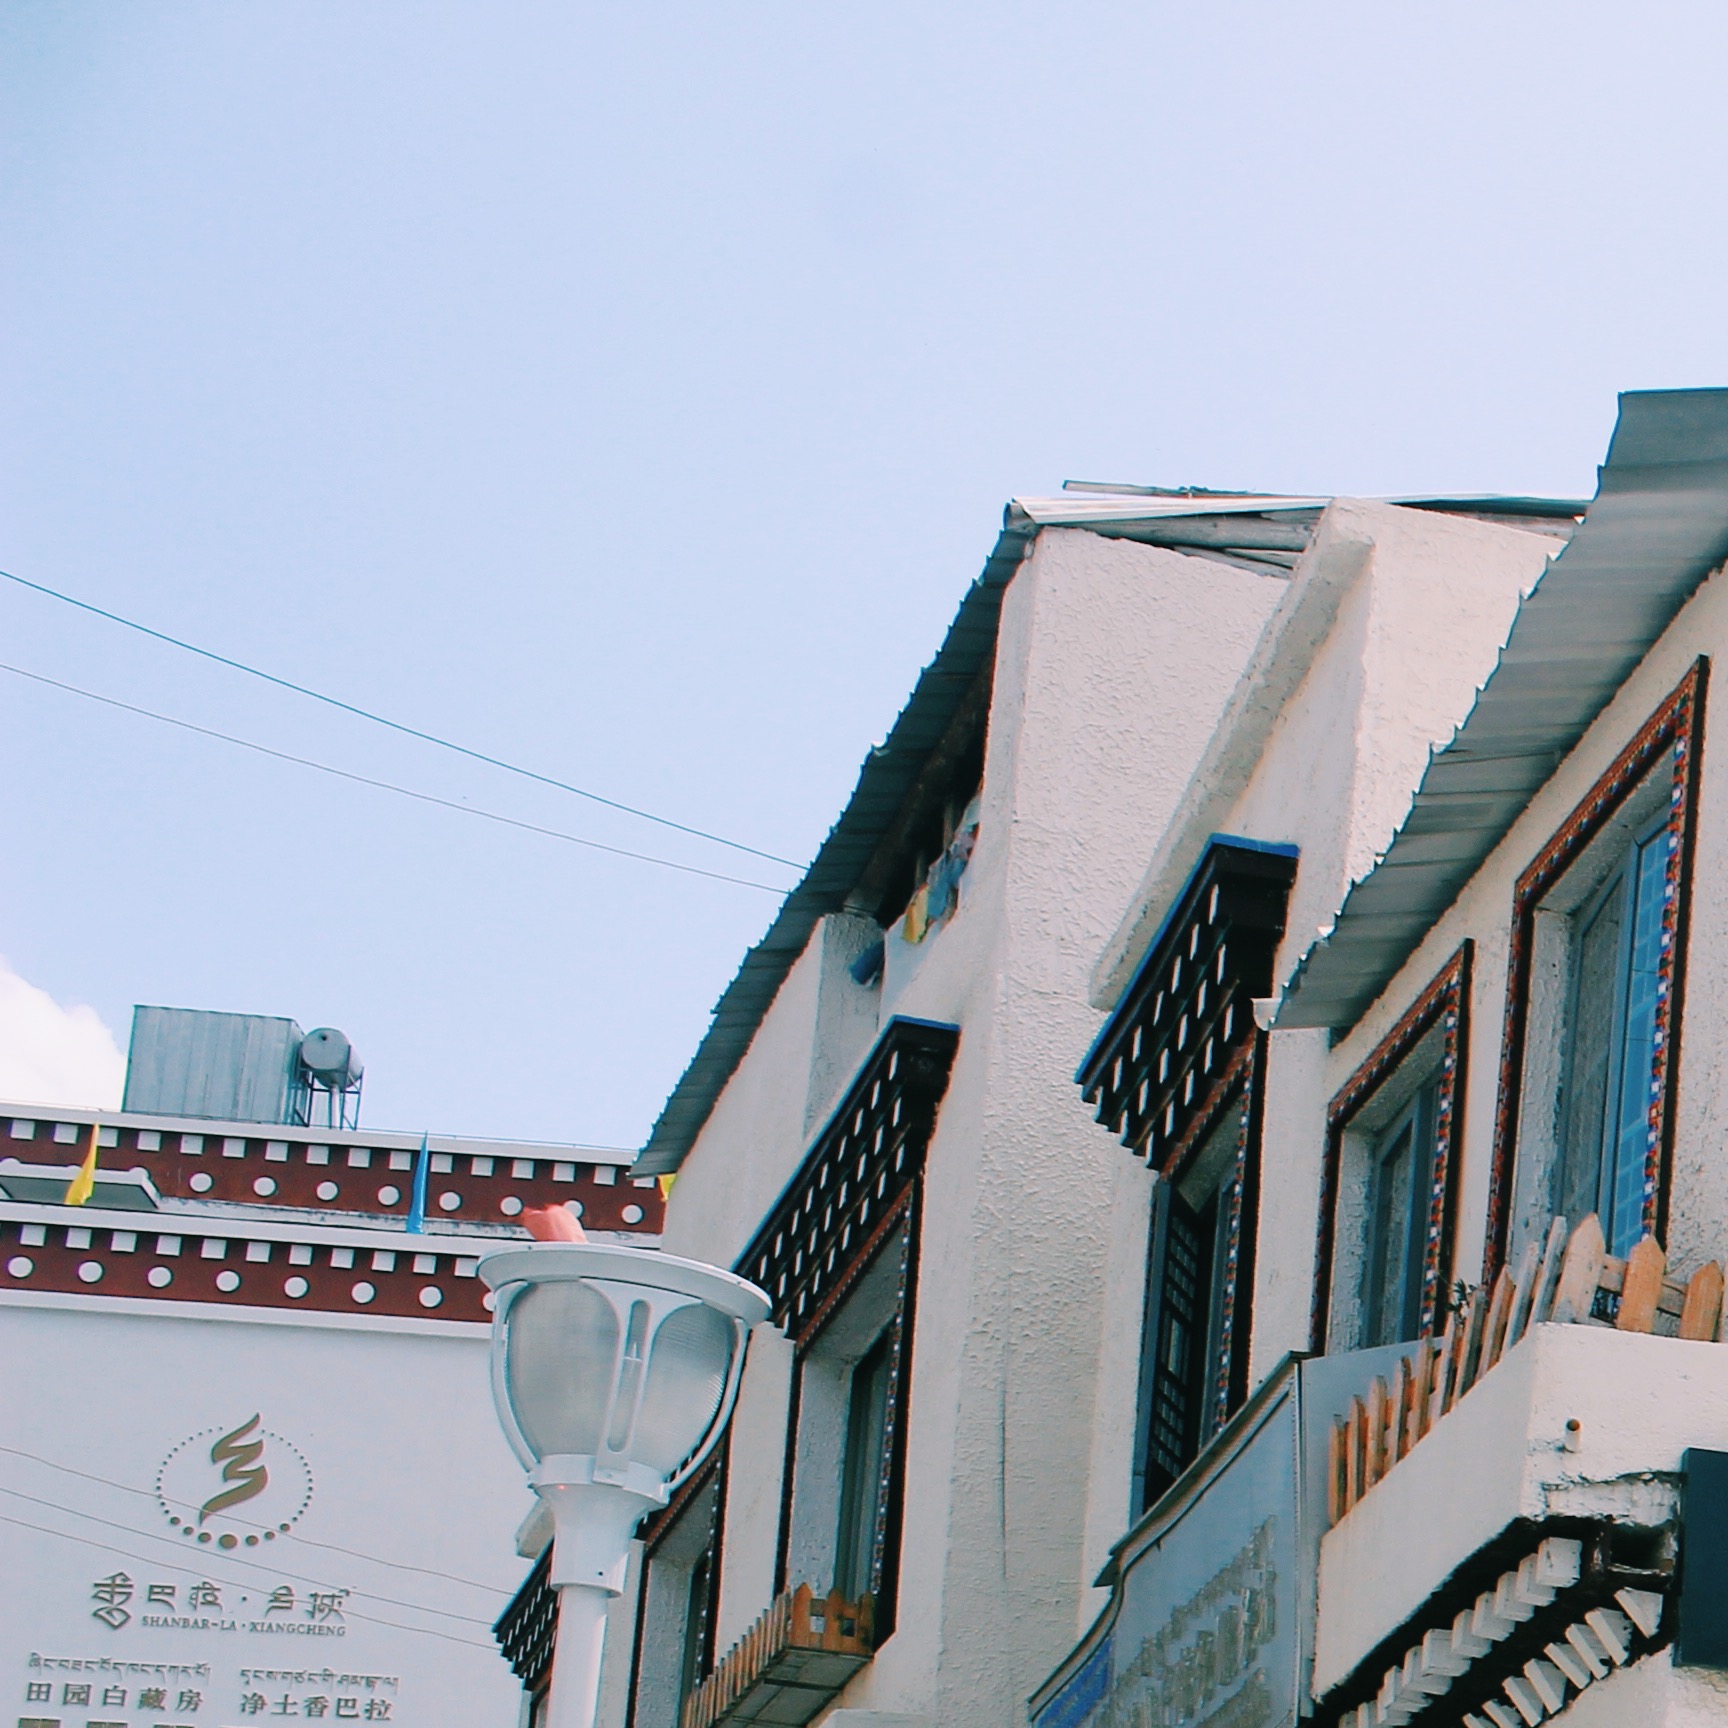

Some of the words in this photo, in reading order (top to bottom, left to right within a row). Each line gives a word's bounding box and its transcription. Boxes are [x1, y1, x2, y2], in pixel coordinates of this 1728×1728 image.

[142, 1615, 236, 1631] SHANBAR-LA
[250, 1621, 347, 1637] XIANGCHENG
[26, 1680, 204, 1712] 田园白藏房
[240, 1692, 393, 1721] 净土香巴拉
